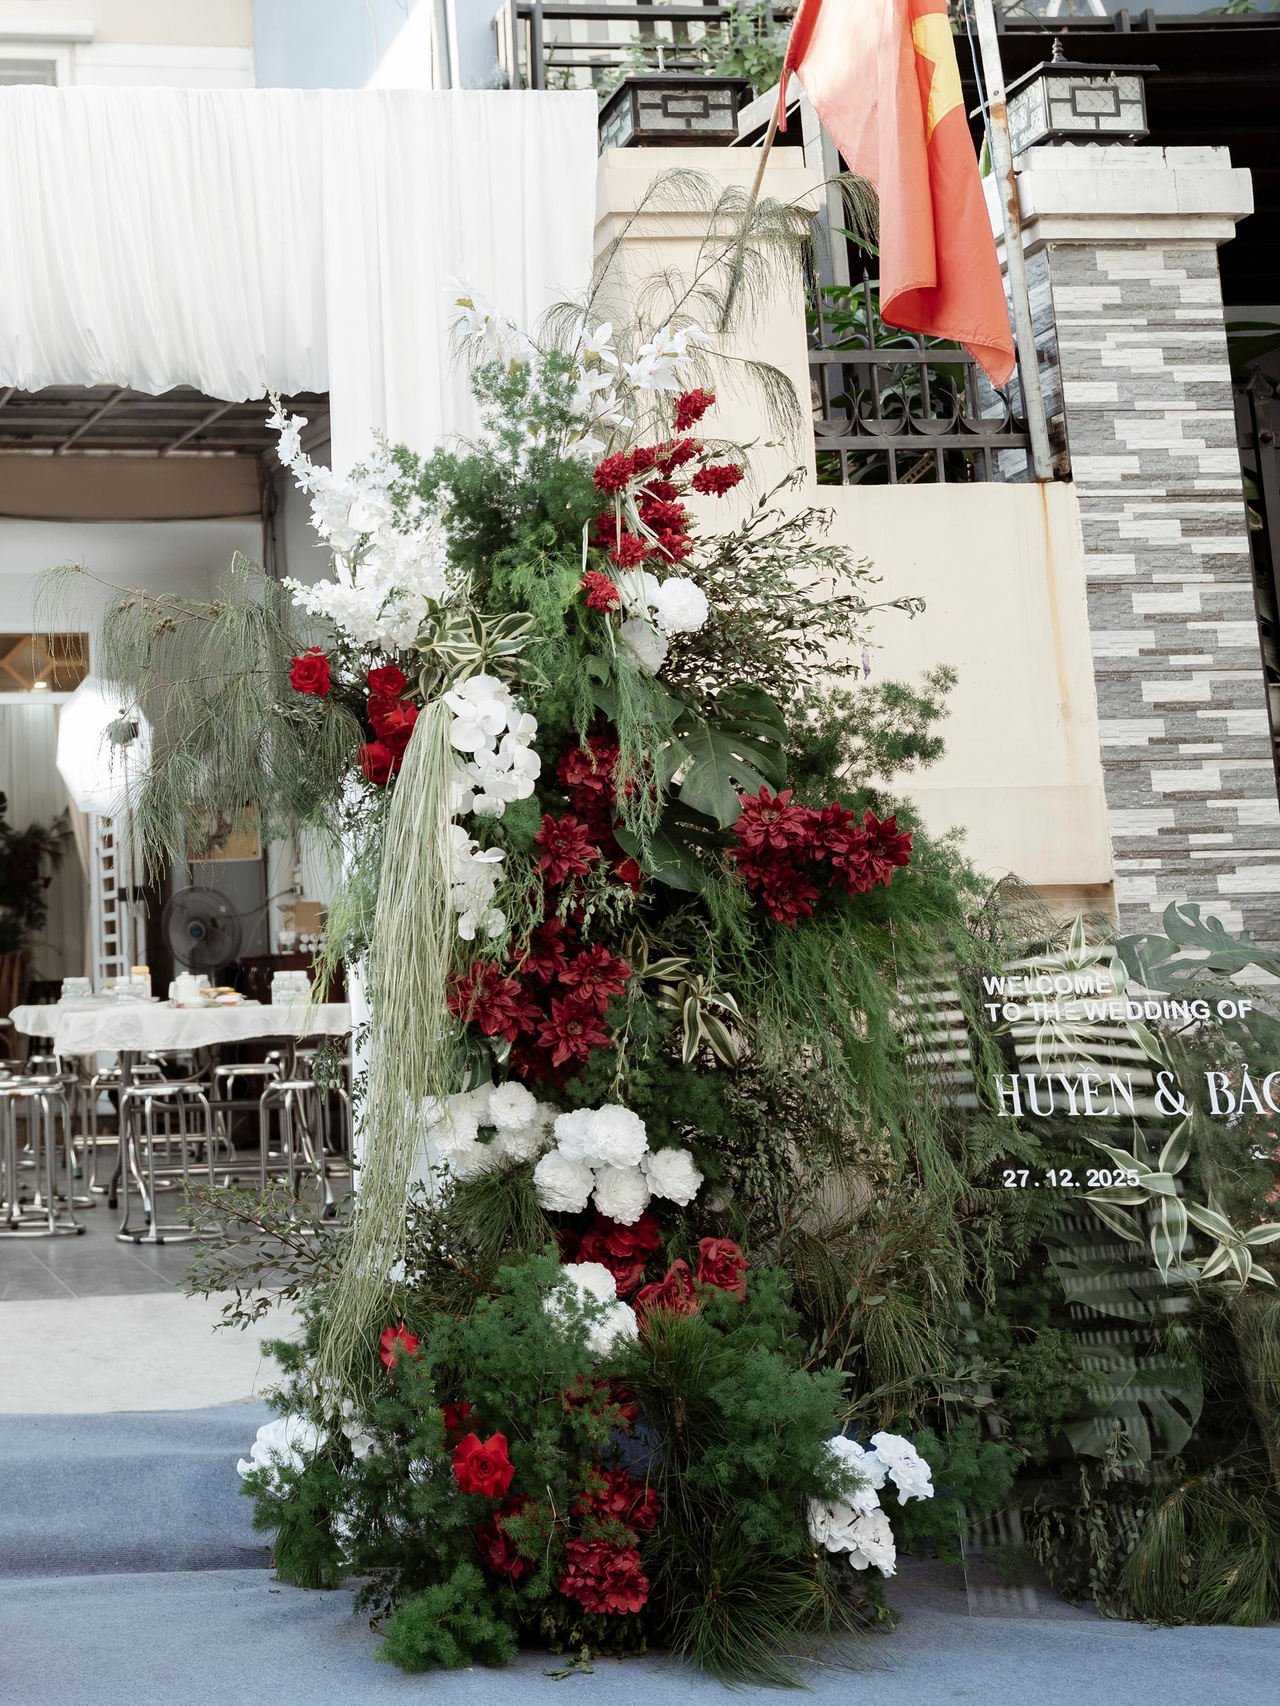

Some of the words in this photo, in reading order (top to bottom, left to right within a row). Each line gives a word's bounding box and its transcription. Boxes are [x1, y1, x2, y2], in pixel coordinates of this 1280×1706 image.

[982, 975, 1112, 995] WELCOME
[984, 1002, 1021, 1022] TO
[1027, 1002, 1077, 1021] THE
[1083, 1000, 1211, 1021] WEDDING
[1217, 999, 1252, 1019] OF
[992, 1063, 1136, 1116] HUYỀN
[1154, 1070, 1193, 1116] &
[1086, 1169, 1141, 1188] 2025
